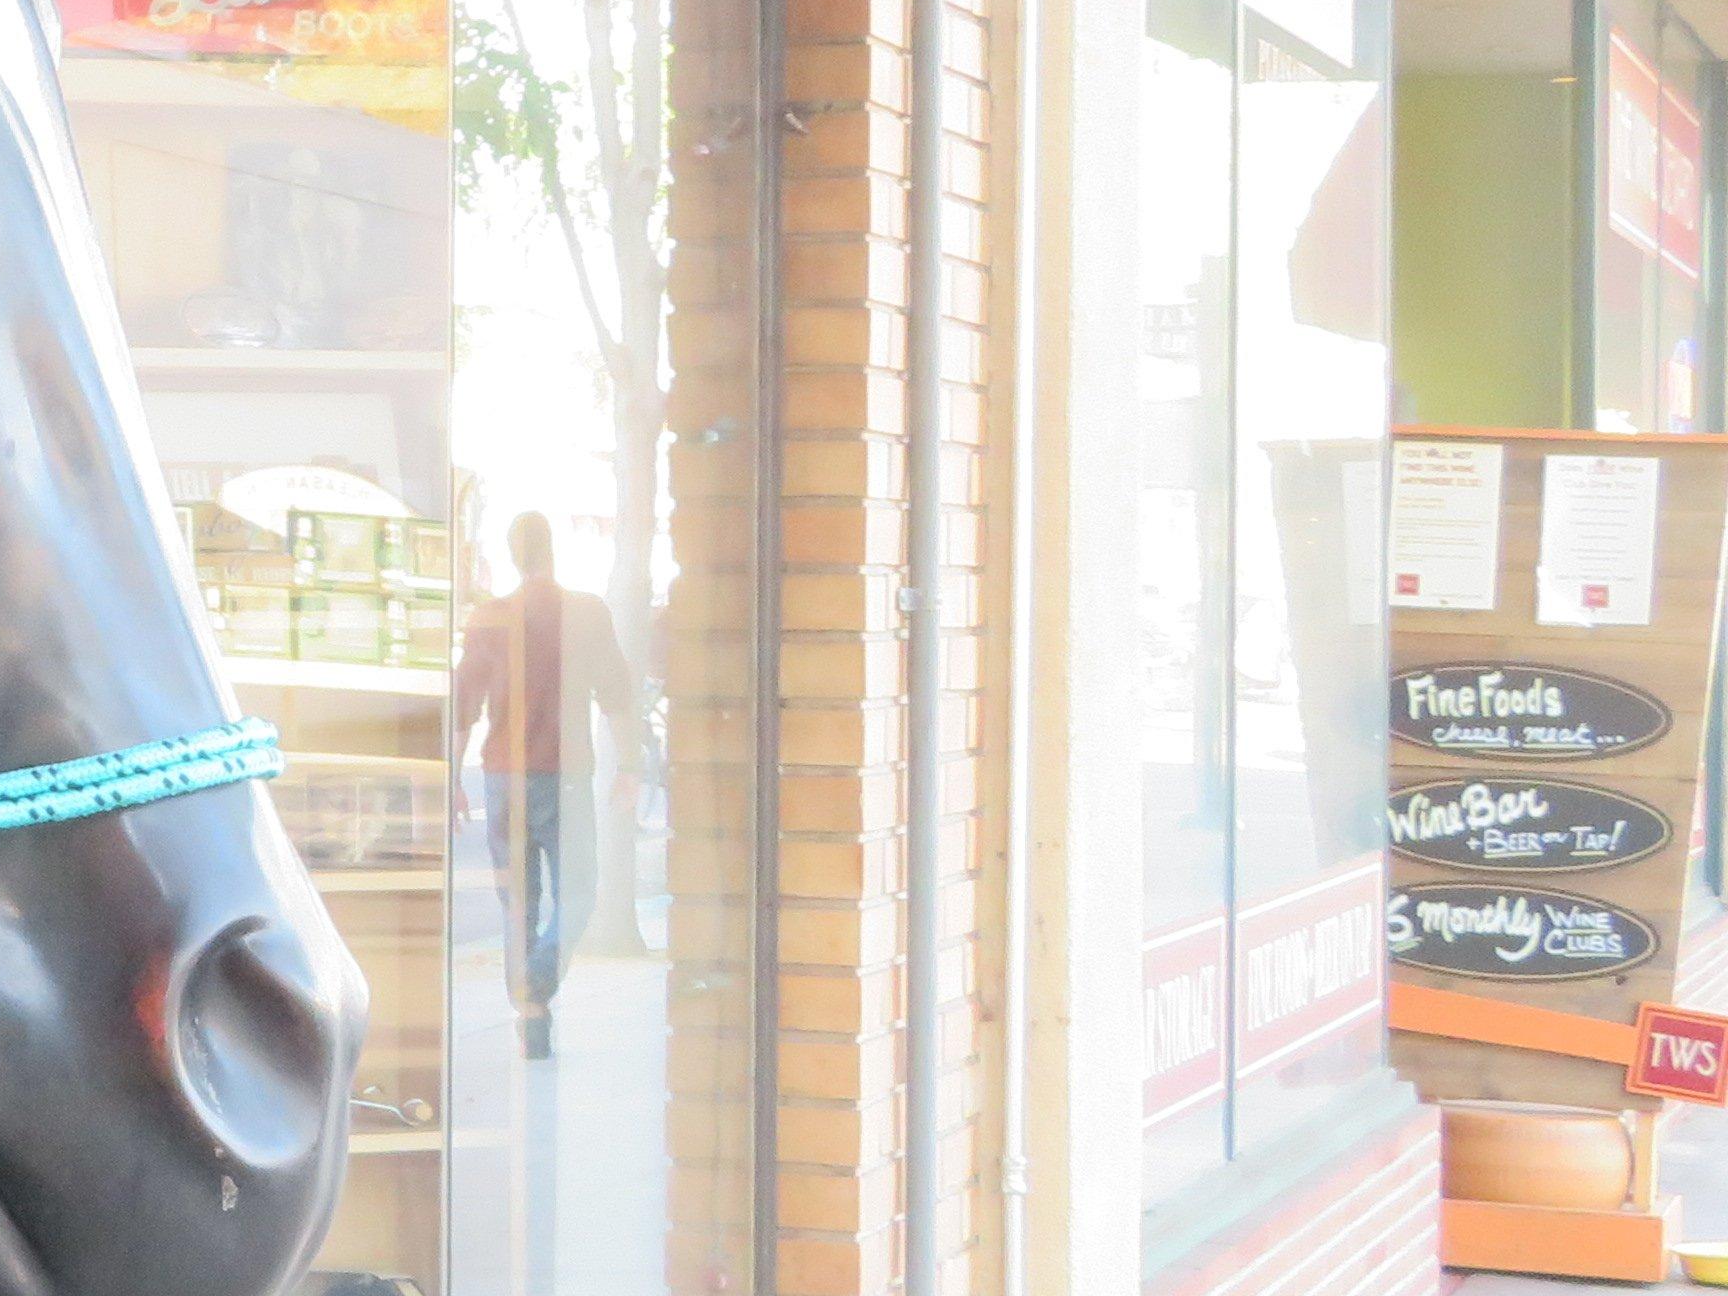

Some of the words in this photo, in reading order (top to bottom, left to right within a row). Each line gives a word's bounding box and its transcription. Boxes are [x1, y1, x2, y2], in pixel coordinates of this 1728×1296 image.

[295, 9, 419, 40] BOOTS
[1406, 674, 1475, 719] Fine
[1478, 671, 1563, 718] Foods
[1387, 793, 1465, 843] Wine
[1461, 783, 1549, 828] Bar
[1545, 904, 1612, 930] WINE
[1544, 932, 1625, 956] CLUBS
[1650, 1032, 1717, 1078] TWS
